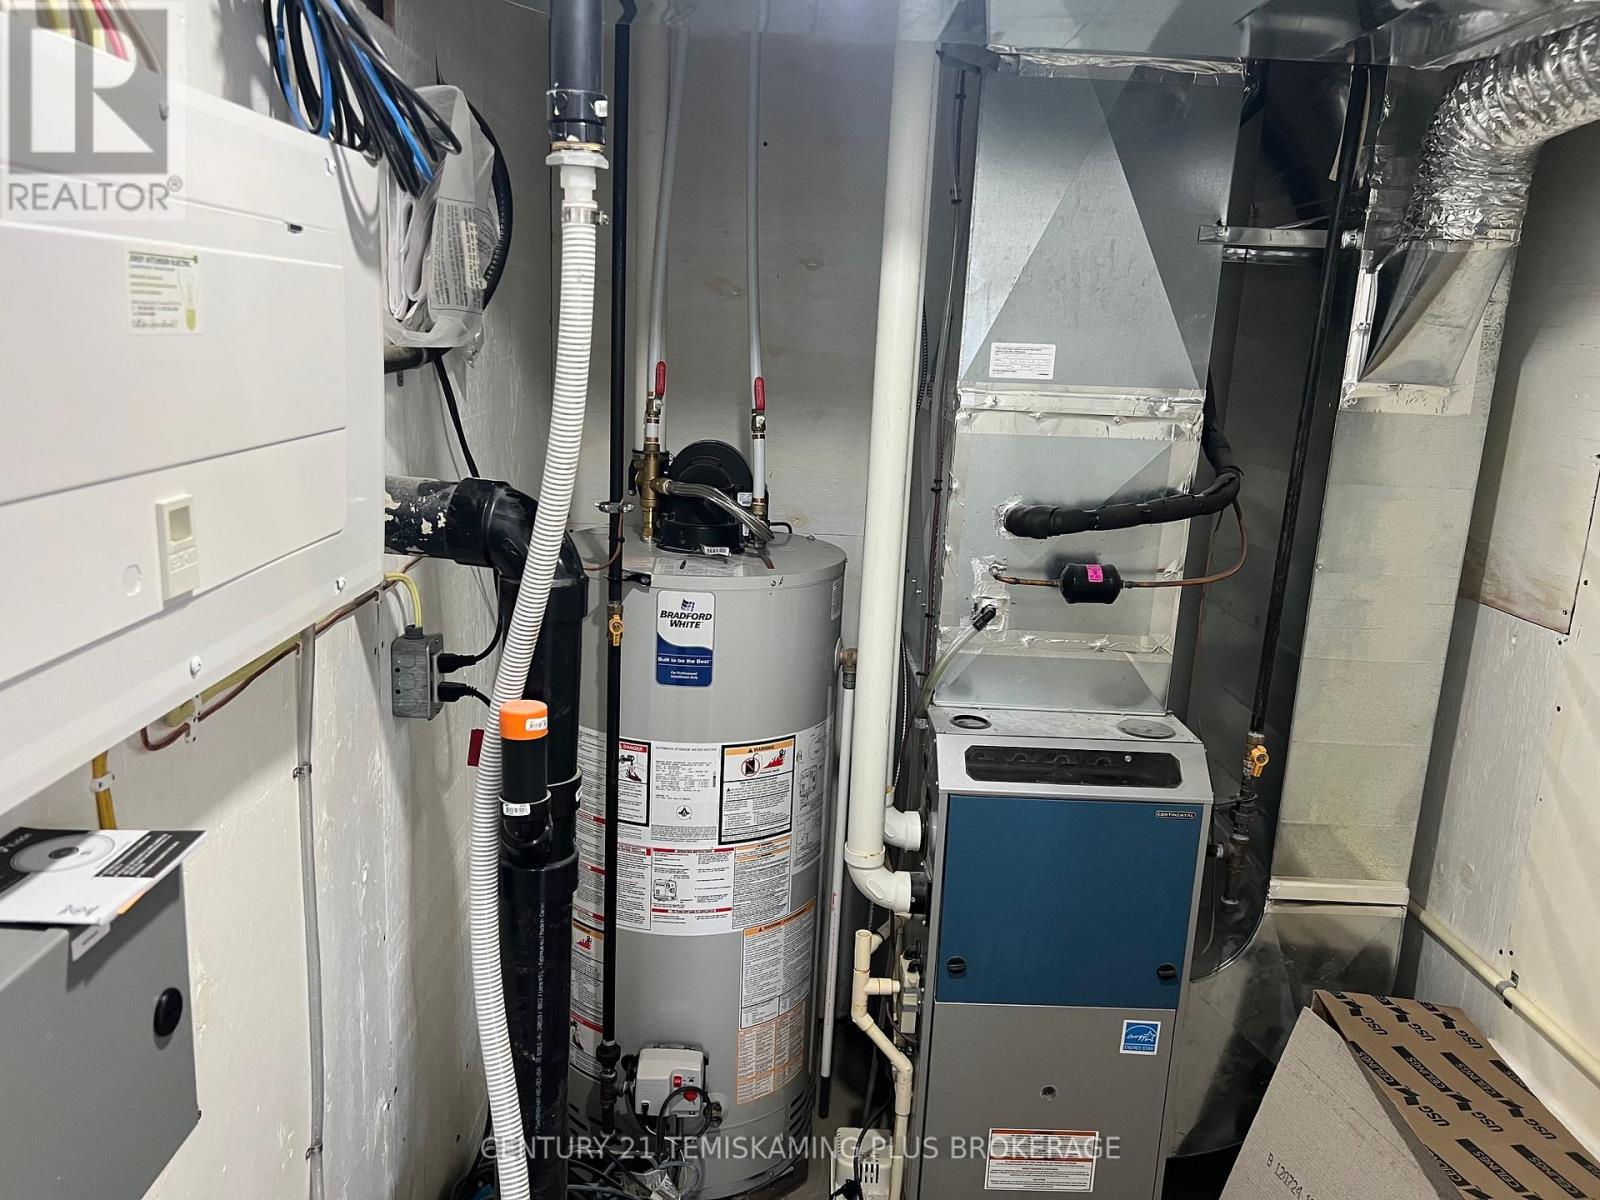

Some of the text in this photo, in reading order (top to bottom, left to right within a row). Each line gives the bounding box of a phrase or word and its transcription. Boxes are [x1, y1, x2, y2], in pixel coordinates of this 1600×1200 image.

[660, 610, 712, 620] BRADFORD
[669, 620, 701, 629] WHITE
[1361, 1016, 1389, 1036] USG
[1408, 1022, 1437, 1042] USG
[1454, 1029, 1484, 1049] USG
[1356, 1050, 1395, 1083] CEILINGS
[1405, 1056, 1446, 1089] CEILINGS
[1456, 1063, 1496, 1095] CEILINGS
[1418, 1105, 1450, 1127] USG
[1471, 1111, 1504, 1133] USG
[1524, 1118, 1557, 1140] USG
[1473, 1150, 1520, 1188] CEILINGS
[1528, 1156, 1579, 1195] CEILINGS
